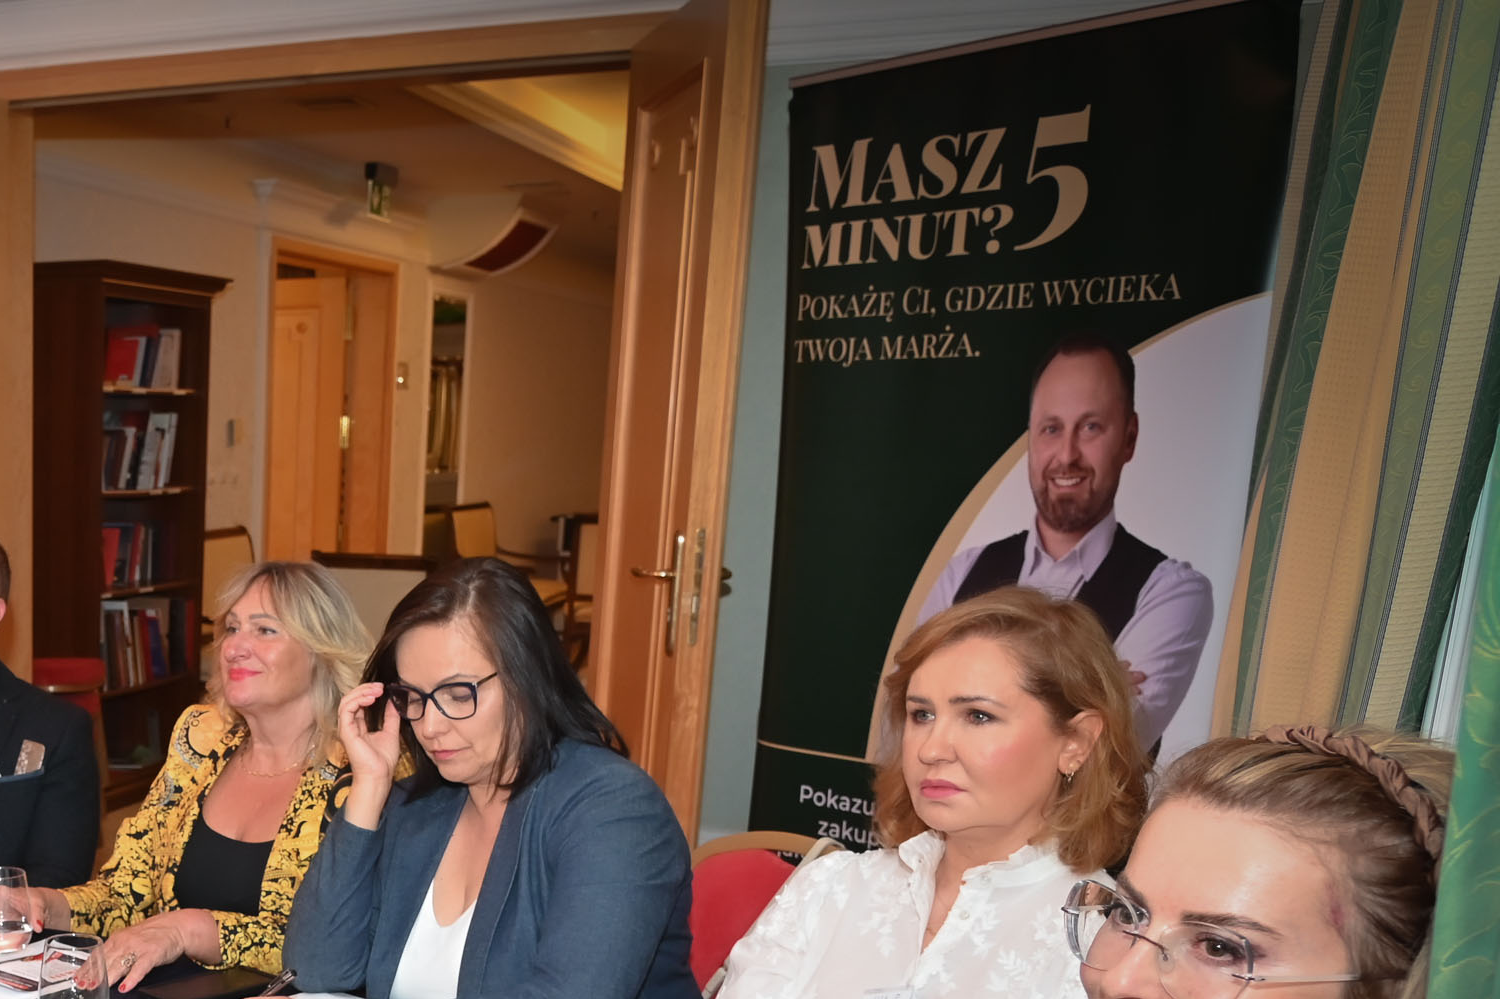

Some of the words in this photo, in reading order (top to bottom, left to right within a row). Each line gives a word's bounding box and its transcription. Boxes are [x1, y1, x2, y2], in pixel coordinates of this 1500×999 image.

[806, 126, 1007, 213] MASZ
[1014, 104, 1091, 252] 5
[802, 204, 1014, 270] MINUT?
[797, 285, 894, 322] POKAŻĘ
[945, 281, 1034, 314] GDZIE
[1043, 273, 1181, 307] WYCIEKA
[795, 336, 874, 367] TWOJA
[880, 325, 981, 361] MARŻA.
